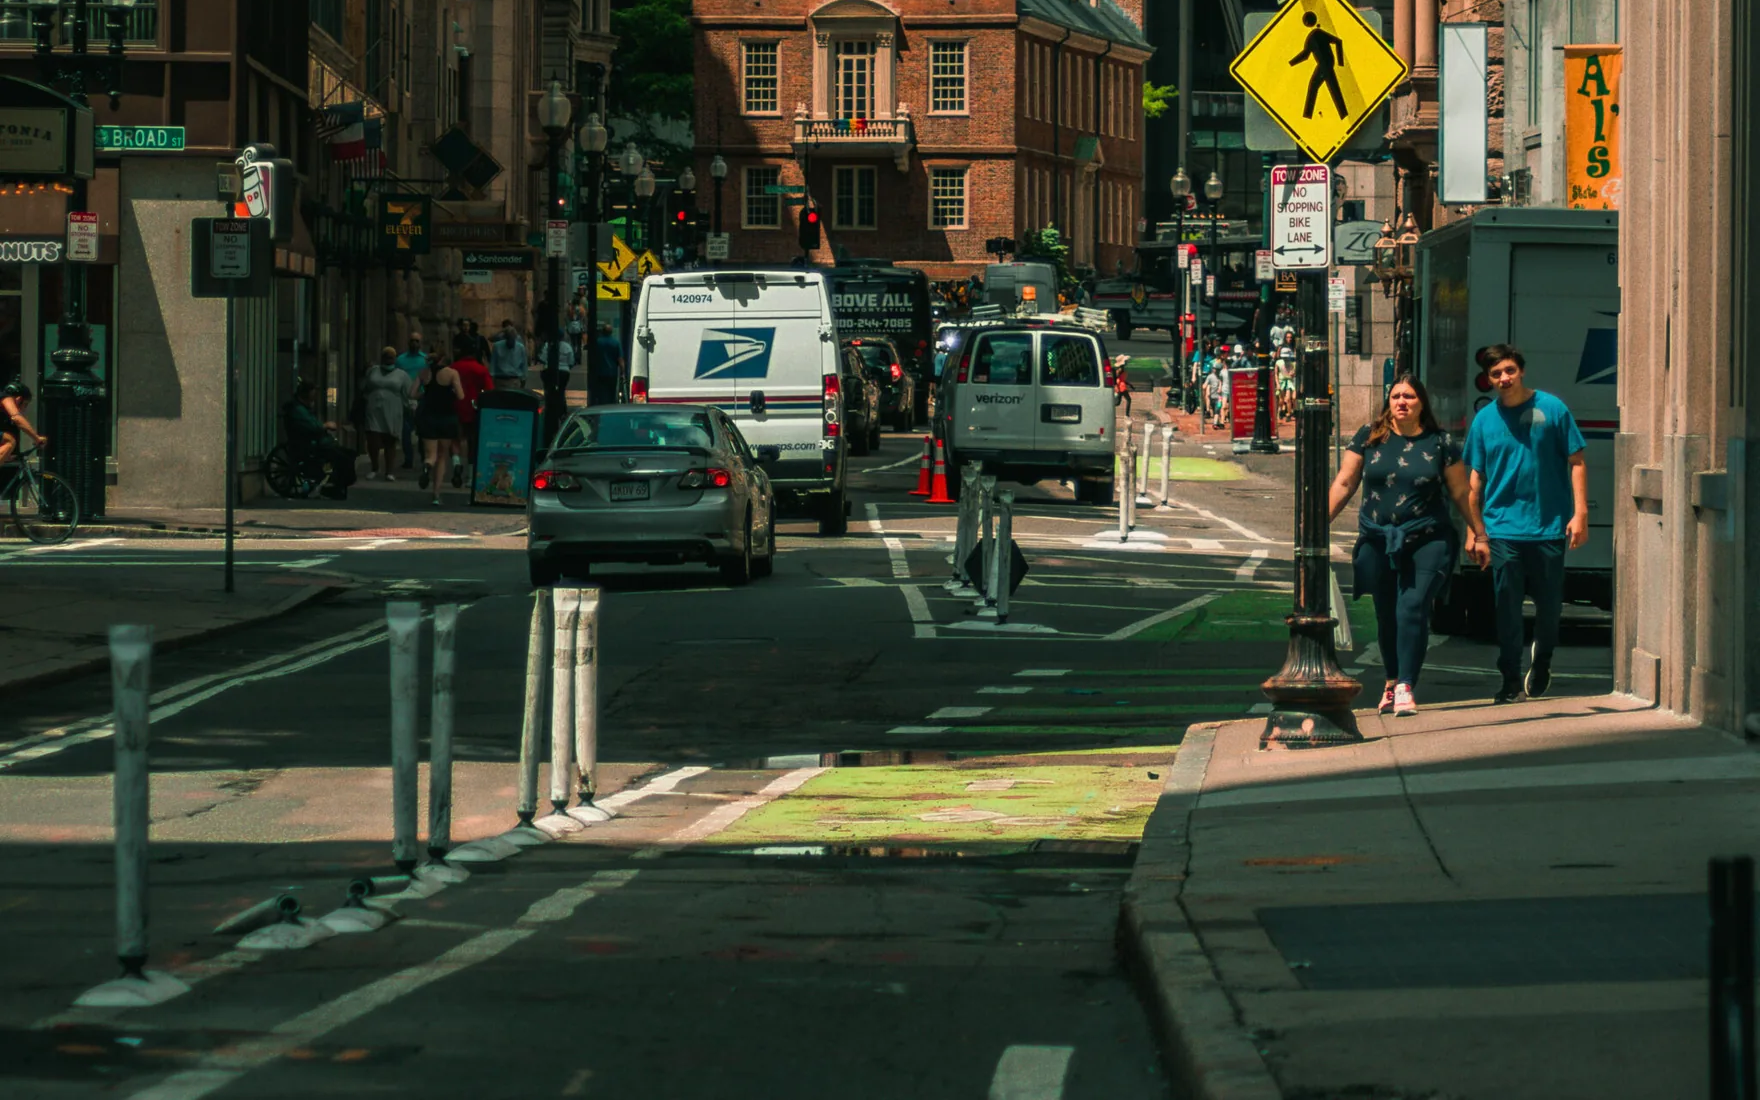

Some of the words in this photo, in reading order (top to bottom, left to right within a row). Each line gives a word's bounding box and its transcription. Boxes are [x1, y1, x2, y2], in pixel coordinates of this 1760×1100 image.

[113, 129, 167, 146] BROAD
[171, 137, 182, 146] ST
[1274, 170, 1296, 182] TOW
[1299, 169, 1326, 181] ZONE
[1292, 187, 1307, 198] NO
[1277, 201, 1323, 213] STOPPING
[215, 222, 229, 232] TOW
[230, 222, 247, 232] ZONE
[1289, 217, 1311, 228] BIKE
[223, 235, 237, 243] NO
[1287, 232, 1312, 243] LANE
[477, 254, 523, 264] Santander
[672, 294, 712, 304] 1420974
[881, 293, 913, 307] ALL
[975, 393, 1020, 404] verizon
